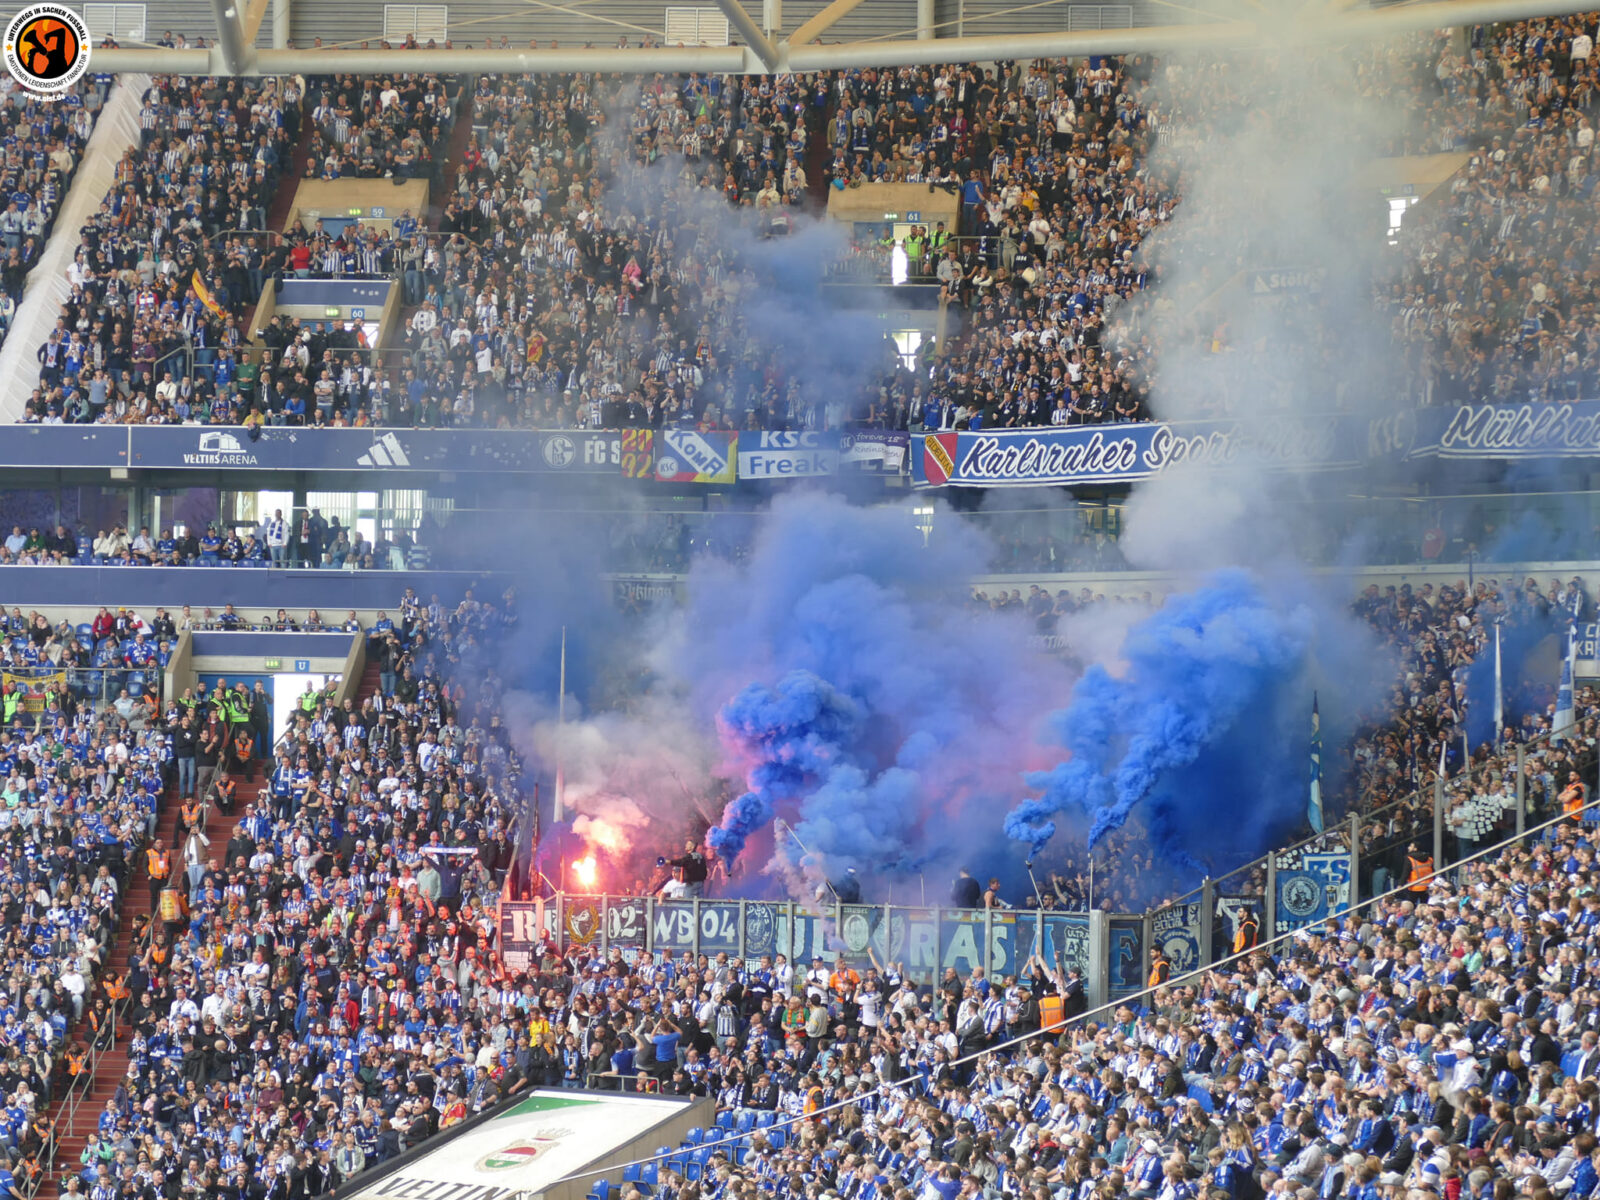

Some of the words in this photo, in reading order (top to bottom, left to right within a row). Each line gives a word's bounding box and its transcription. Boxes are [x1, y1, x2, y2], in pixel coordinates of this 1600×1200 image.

[372, 208, 383, 217] 59
[908, 213, 918, 221] 61
[352, 310, 364, 318] 60
[760, 431, 819, 448] KSC
[221, 454, 258, 465] ARENA
[584, 440, 606, 464] FC
[959, 434, 1136, 477] Karlsruher
[622, 453, 653, 478] 92
[750, 454, 828, 475] Freak
[298, 661, 306, 671] U
[702, 909, 736, 943] 04
